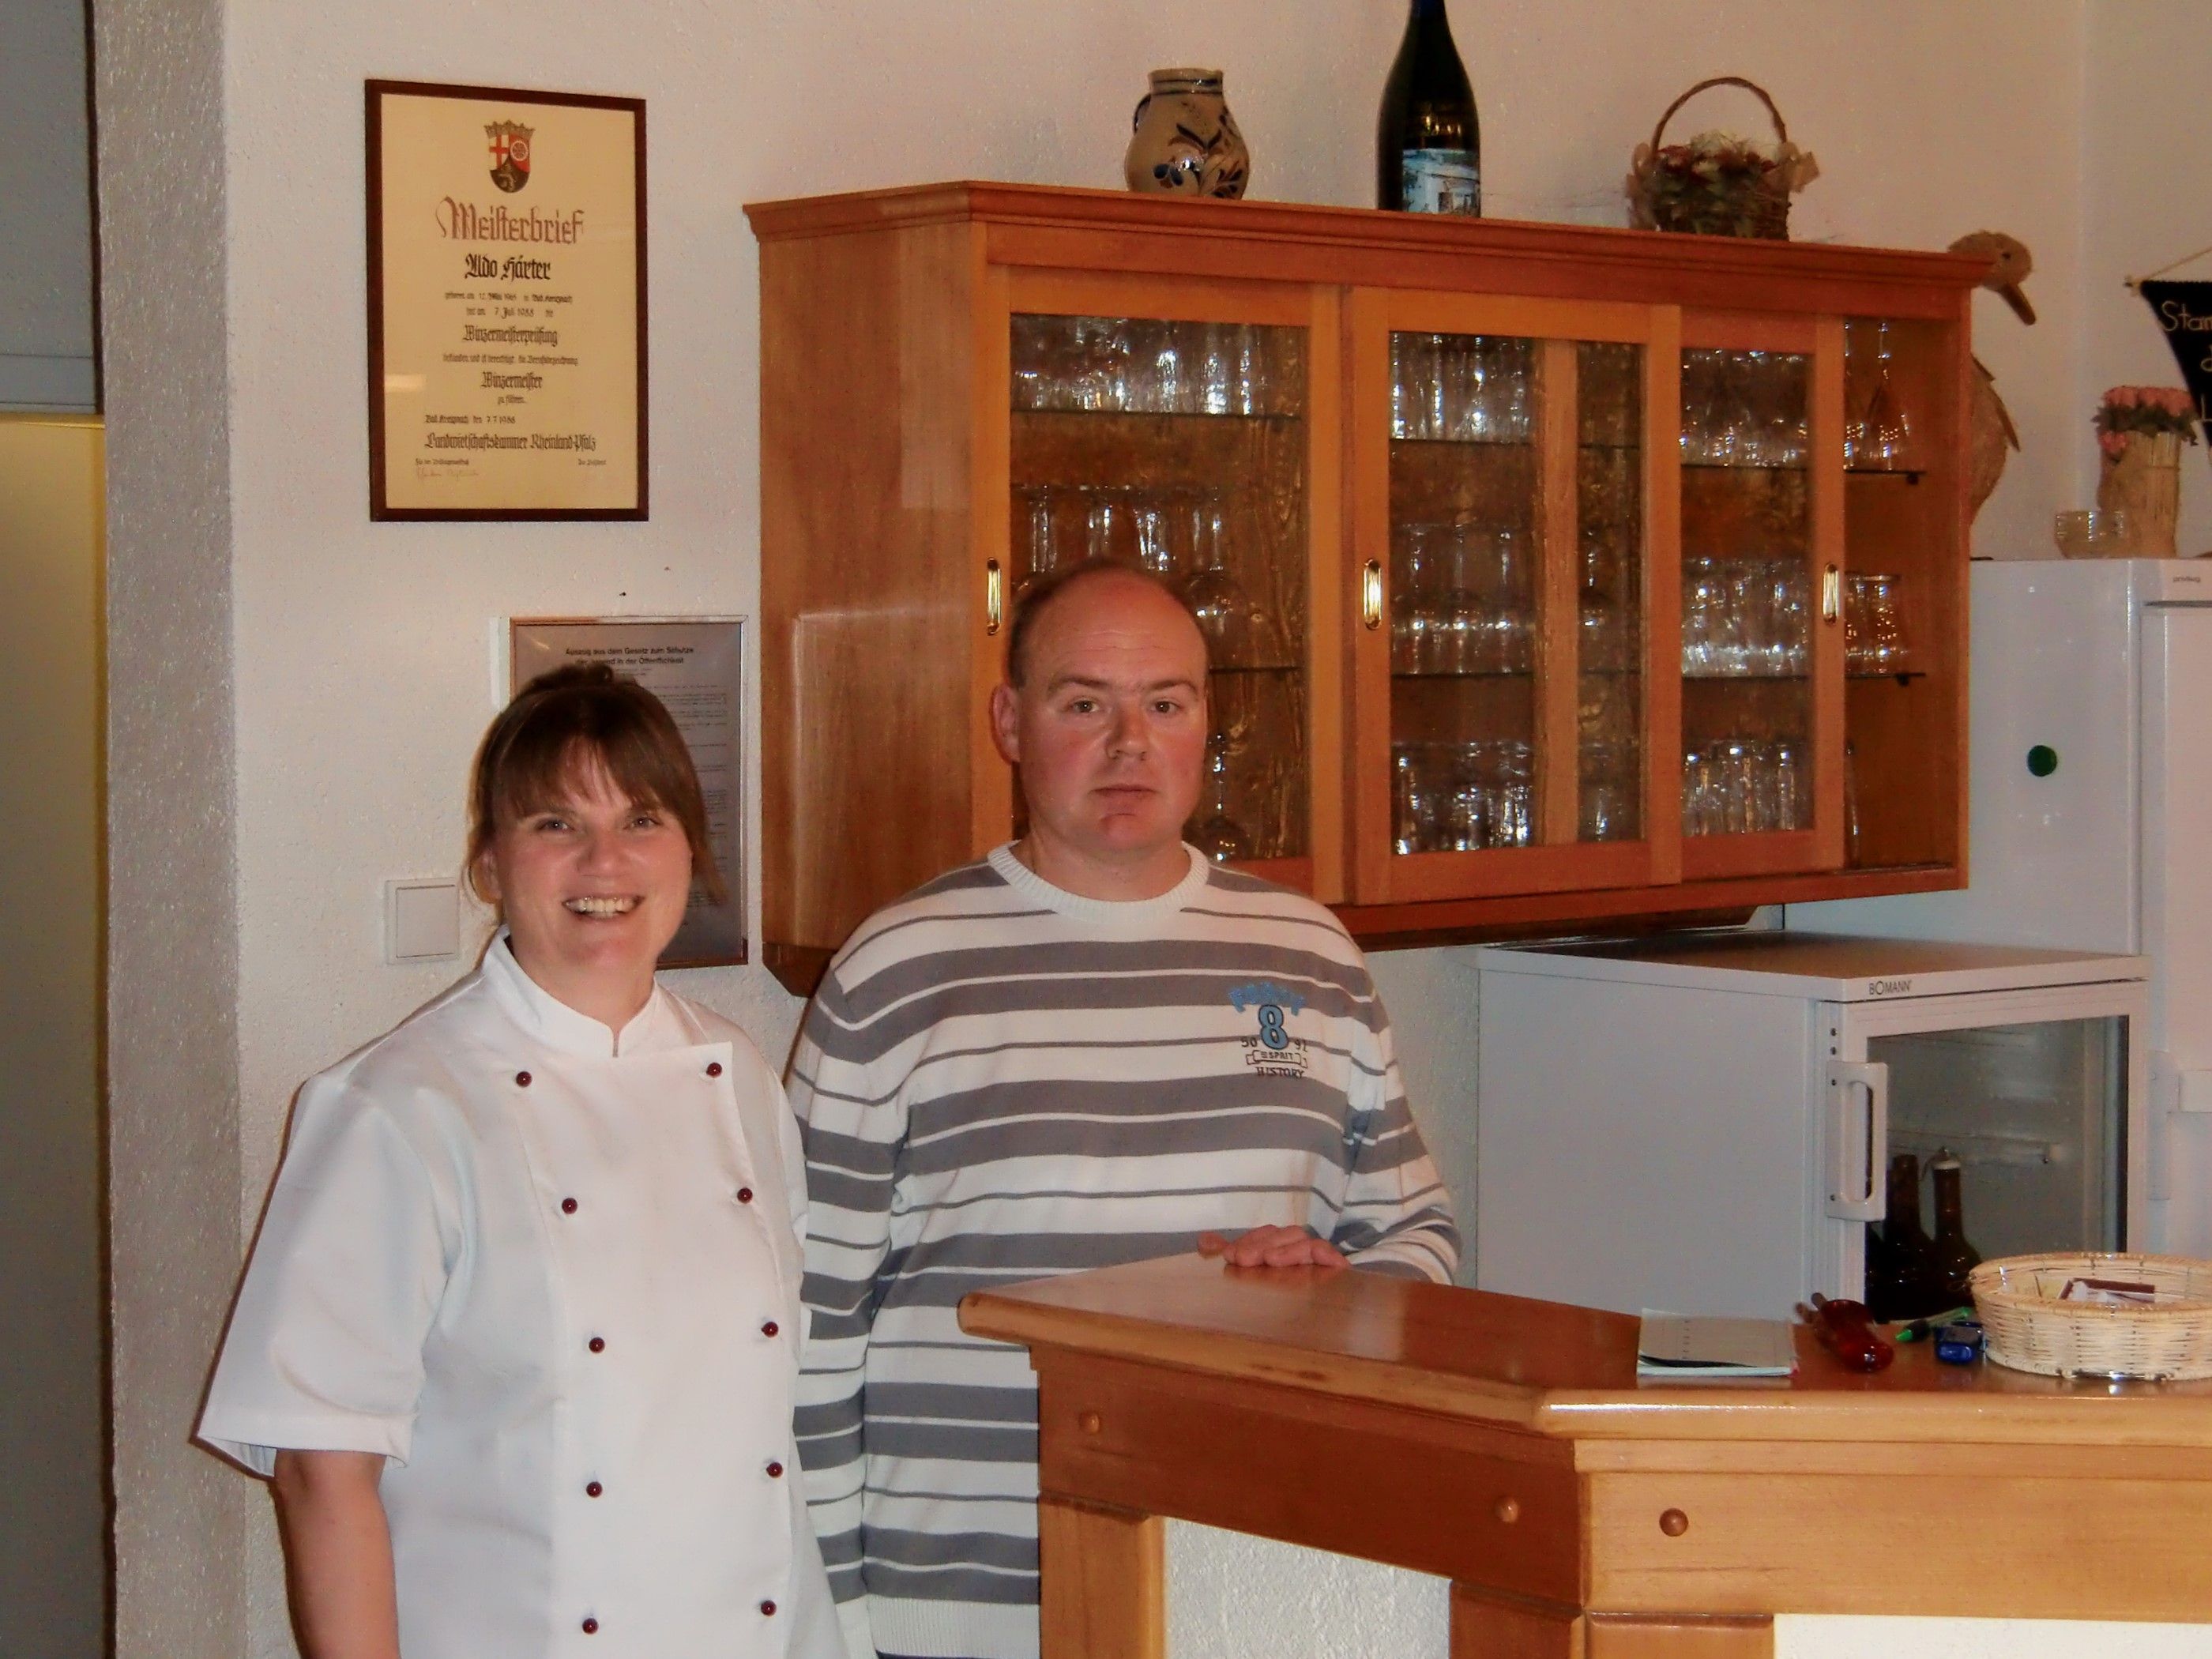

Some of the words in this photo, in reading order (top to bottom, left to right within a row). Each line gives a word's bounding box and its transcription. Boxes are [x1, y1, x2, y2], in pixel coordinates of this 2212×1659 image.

[436, 195, 585, 244] Meisterbrief
[1258, 1004, 1288, 1050] 8
[1261, 1051, 1293, 1060] ESPRIT
[1256, 1066, 1304, 1078] HISTORY
